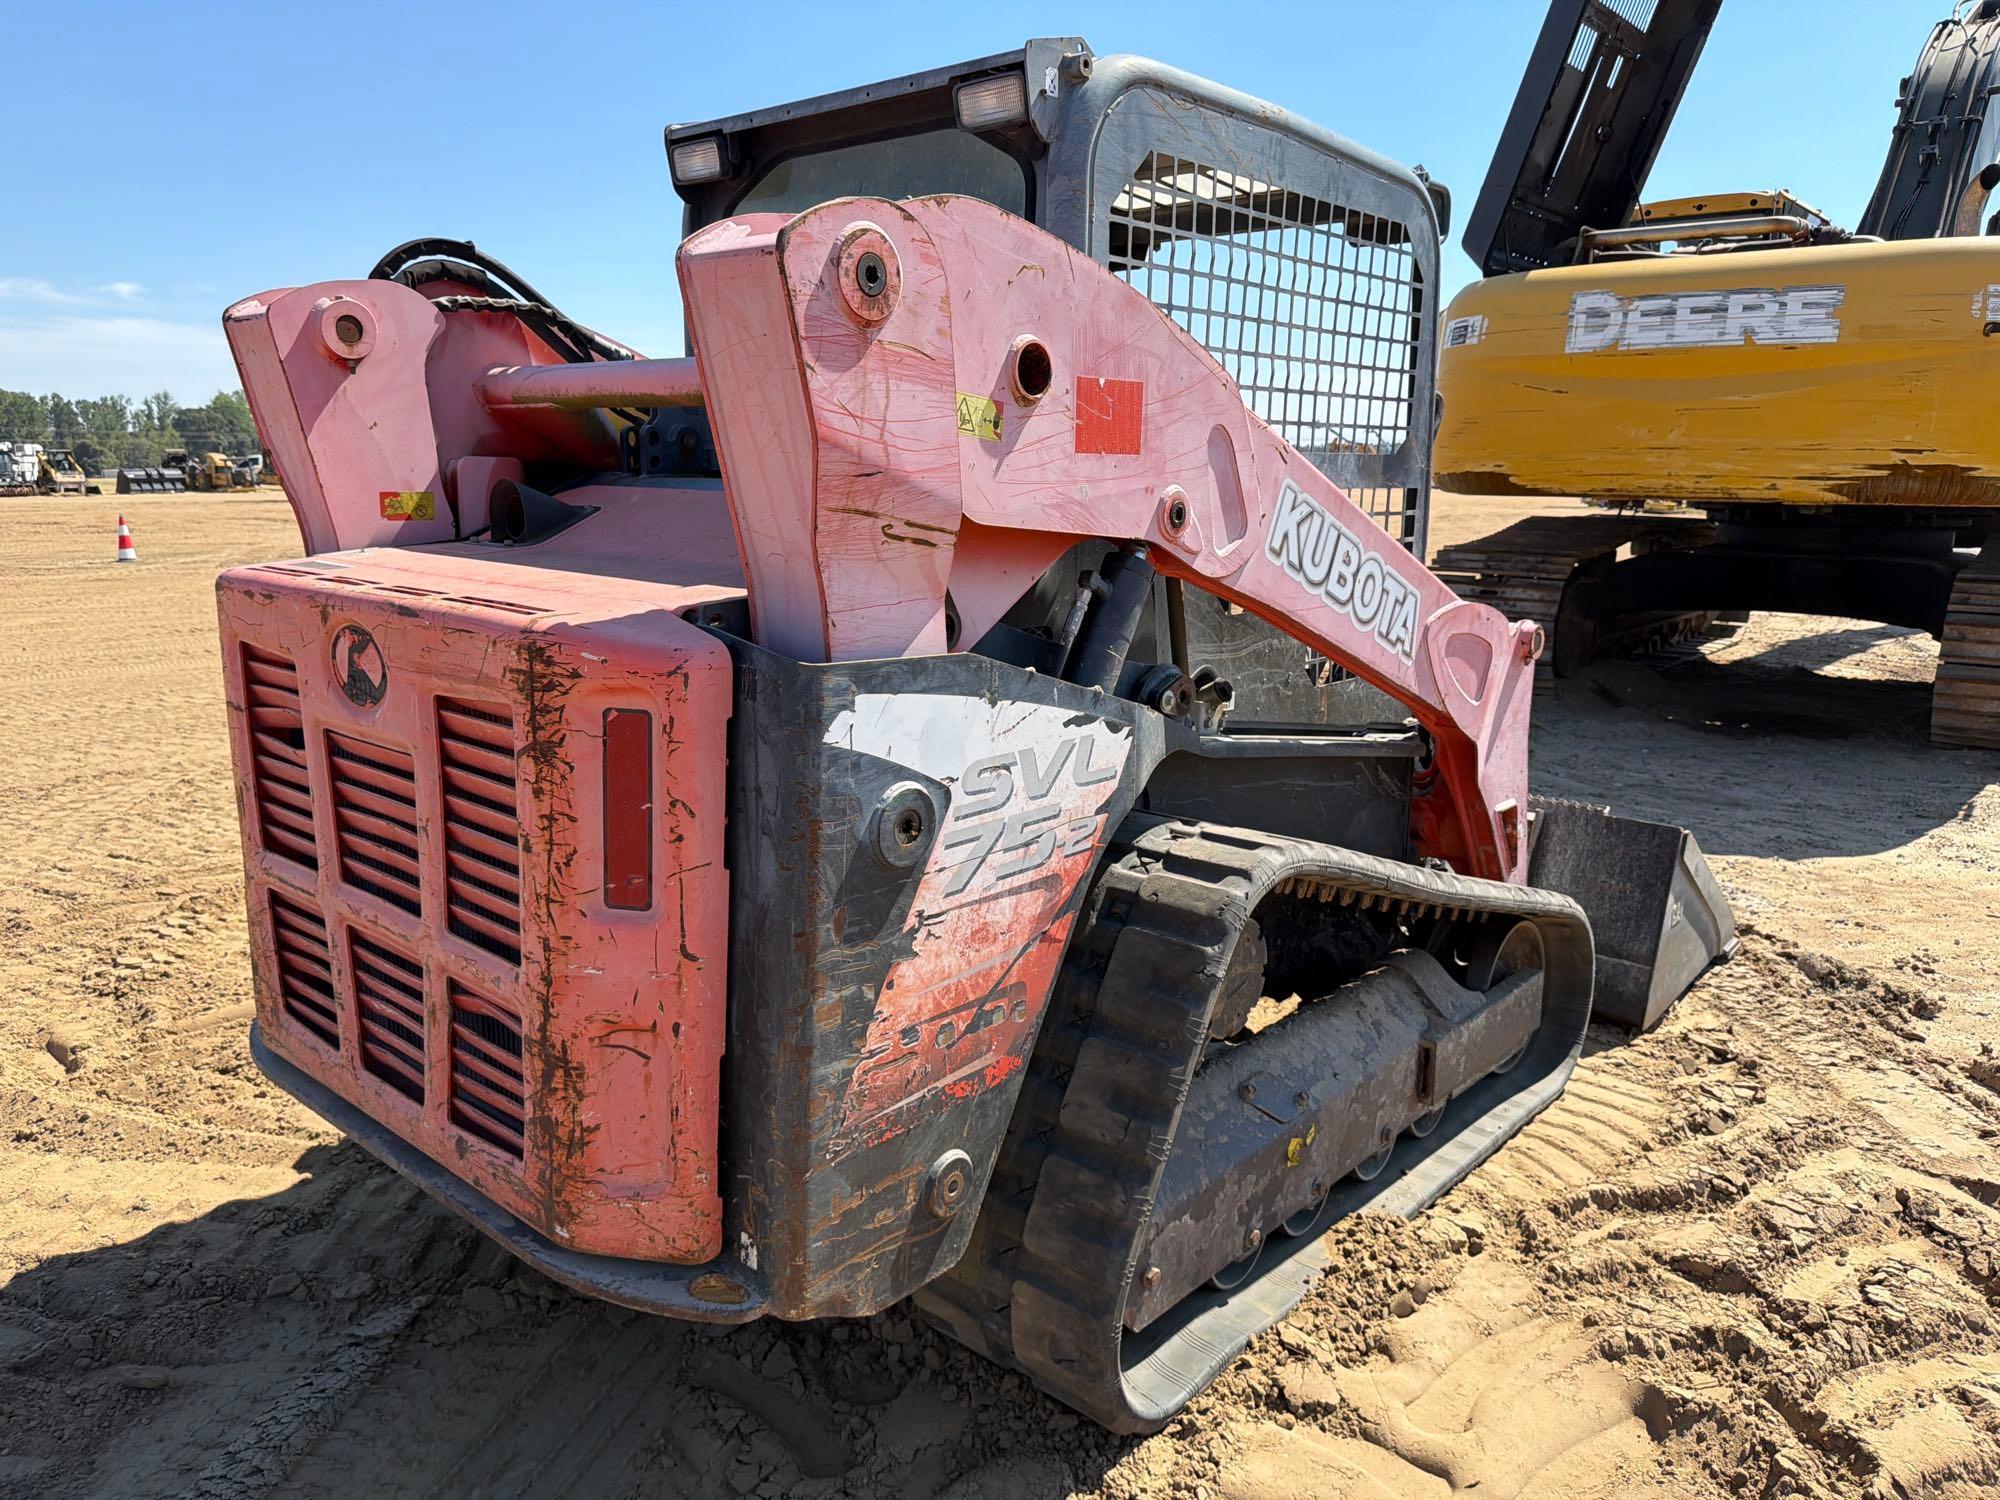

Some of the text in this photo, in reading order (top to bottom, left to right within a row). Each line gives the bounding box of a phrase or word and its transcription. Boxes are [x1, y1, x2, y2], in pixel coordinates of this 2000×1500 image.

[1565, 284, 1845, 353] DEERE
[1268, 485, 1418, 656] KUBOTA
[954, 734, 1118, 822] SVL
